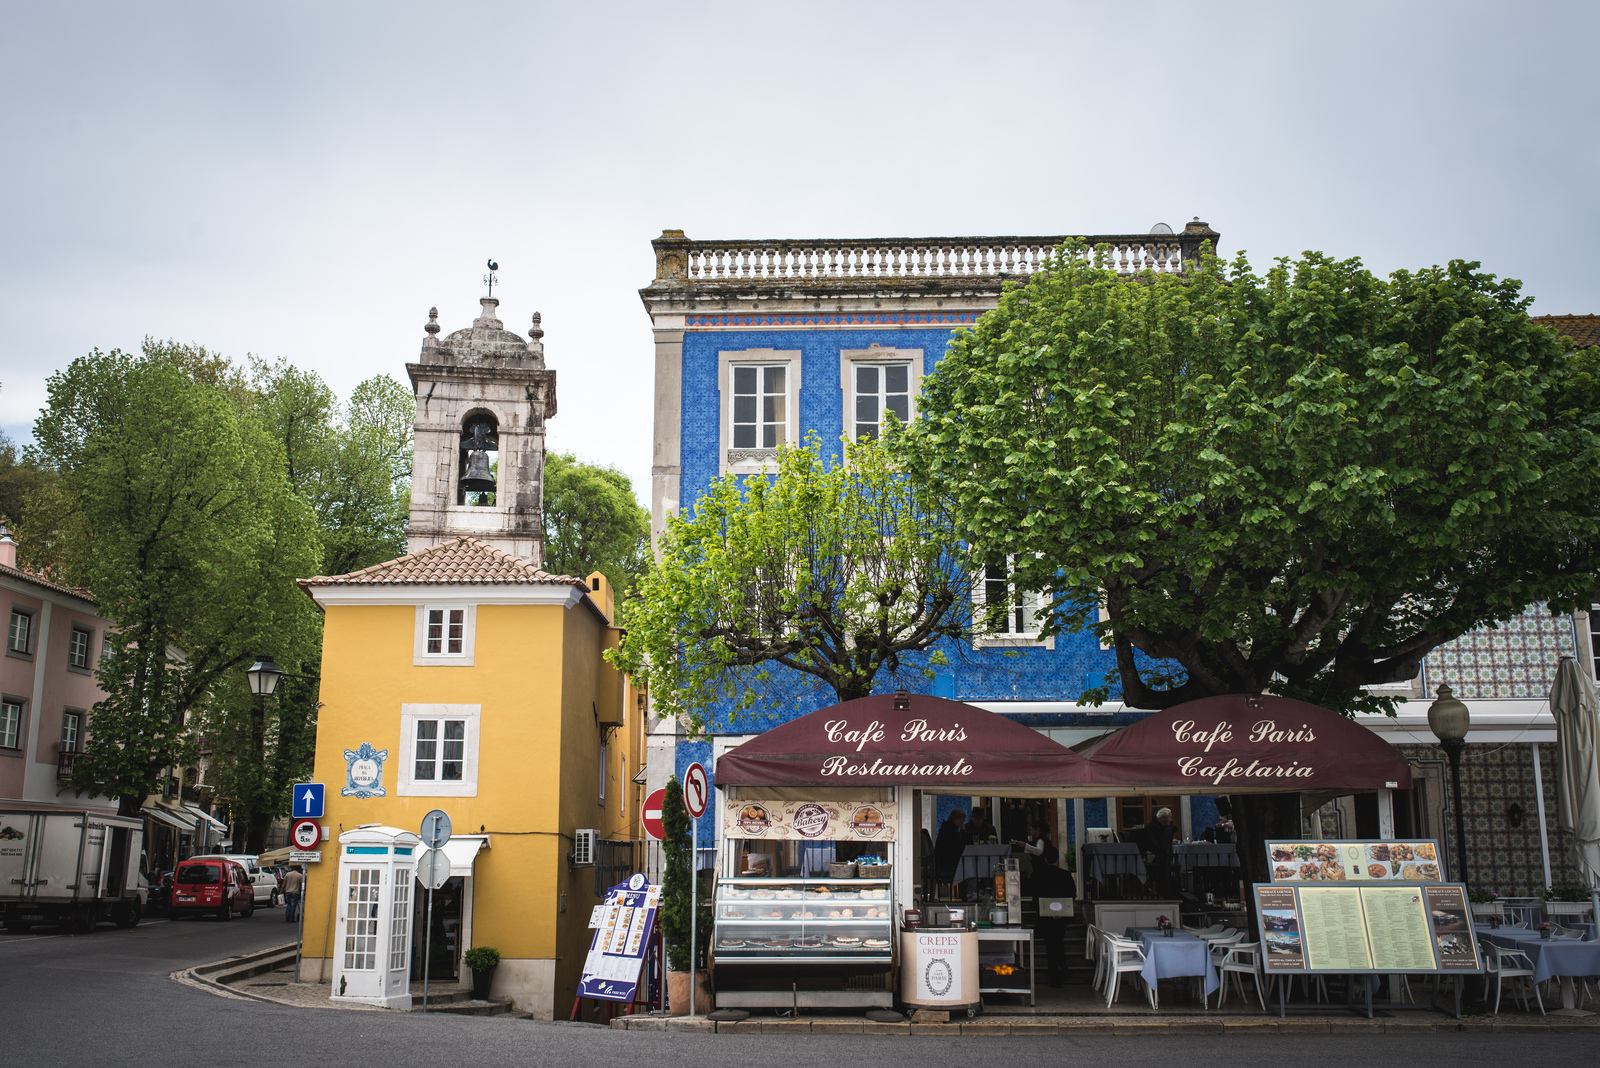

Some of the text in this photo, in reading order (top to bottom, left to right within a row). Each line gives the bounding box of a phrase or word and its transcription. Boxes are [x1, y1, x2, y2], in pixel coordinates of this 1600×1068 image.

[824, 718, 968, 752] Café Paris
[1171, 719, 1317, 752] Café Paris
[820, 755, 974, 776] Restaurante
[1177, 756, 1315, 785] Cafetaria
[794, 816, 827, 828] Bakery
